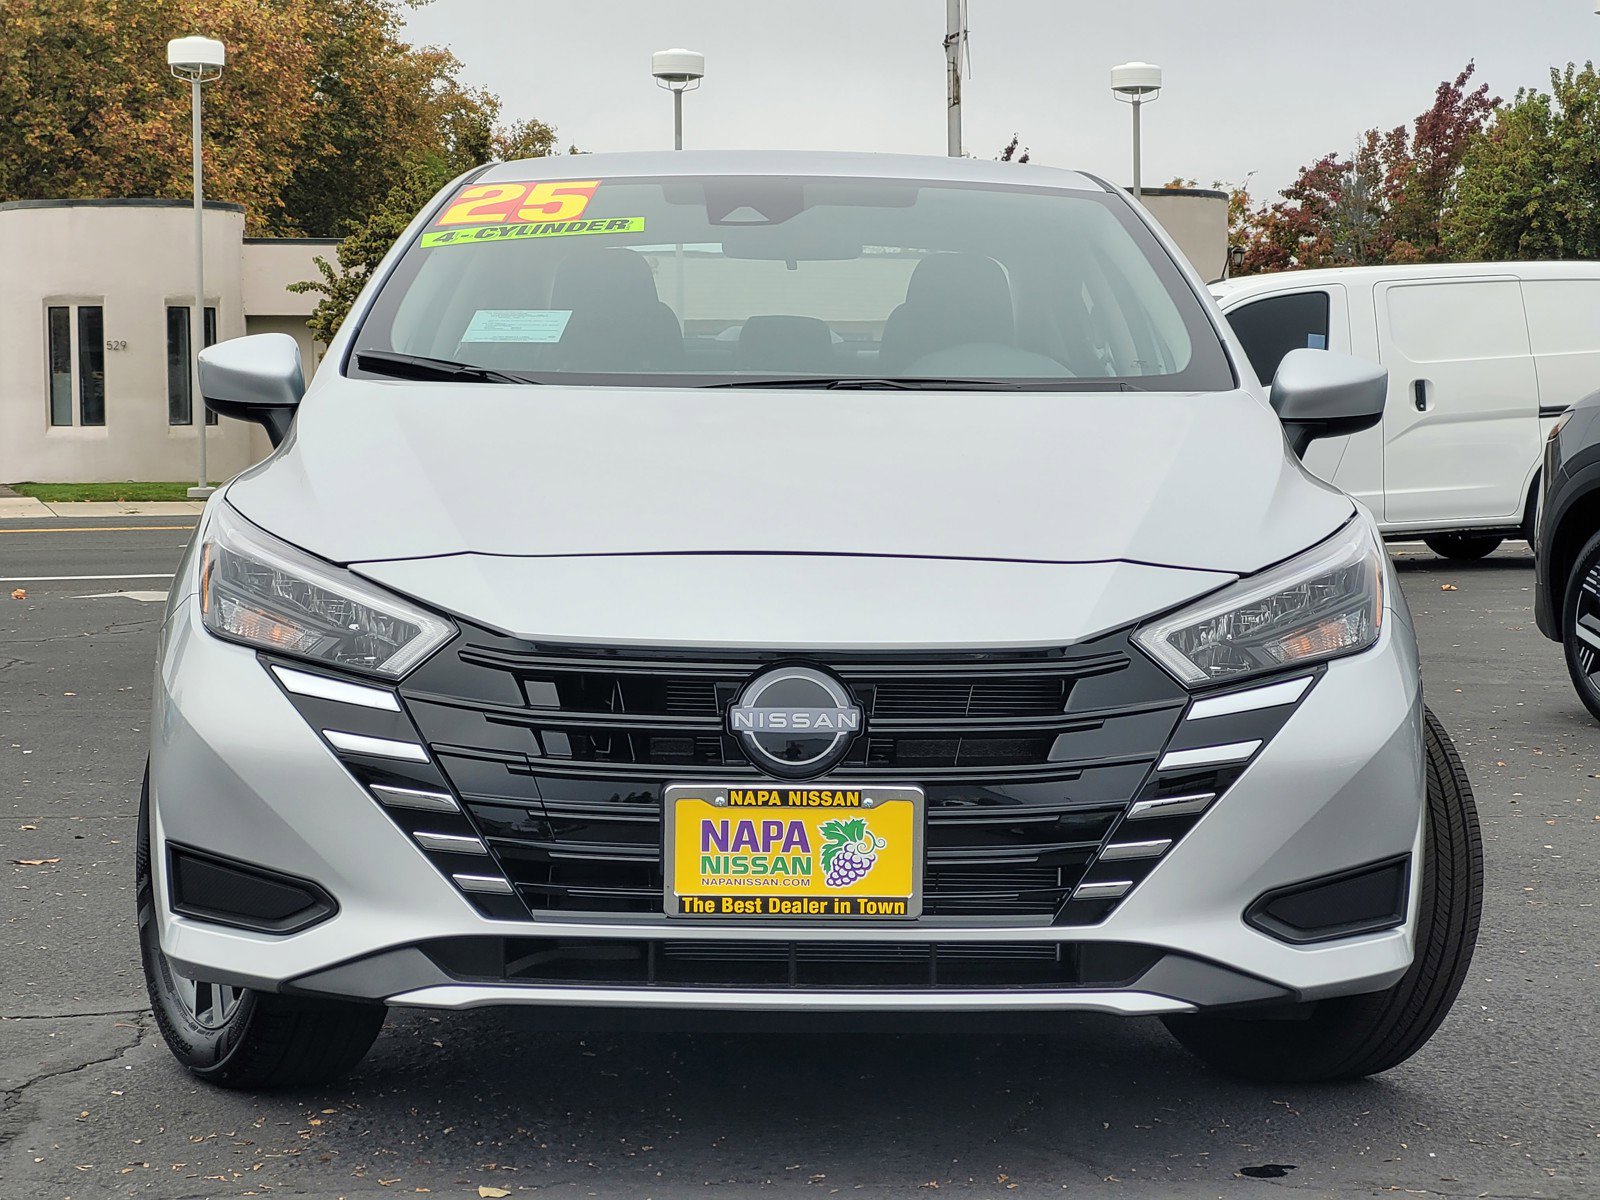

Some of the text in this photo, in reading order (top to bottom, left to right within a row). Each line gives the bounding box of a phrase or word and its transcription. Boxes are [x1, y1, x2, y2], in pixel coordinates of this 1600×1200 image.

[439, 181, 599, 224] 25
[433, 219, 631, 242] 4-CYLINDER
[106, 340, 127, 350] 529
[734, 712, 857, 728] NISSAN
[730, 791, 859, 807] NAPA NISSAN
[701, 820, 811, 852] NAPA
[701, 855, 812, 875] NISSAN
[701, 878, 811, 886] NAPANISSAN.COM
[682, 897, 905, 915] The Best Dealer in Town
